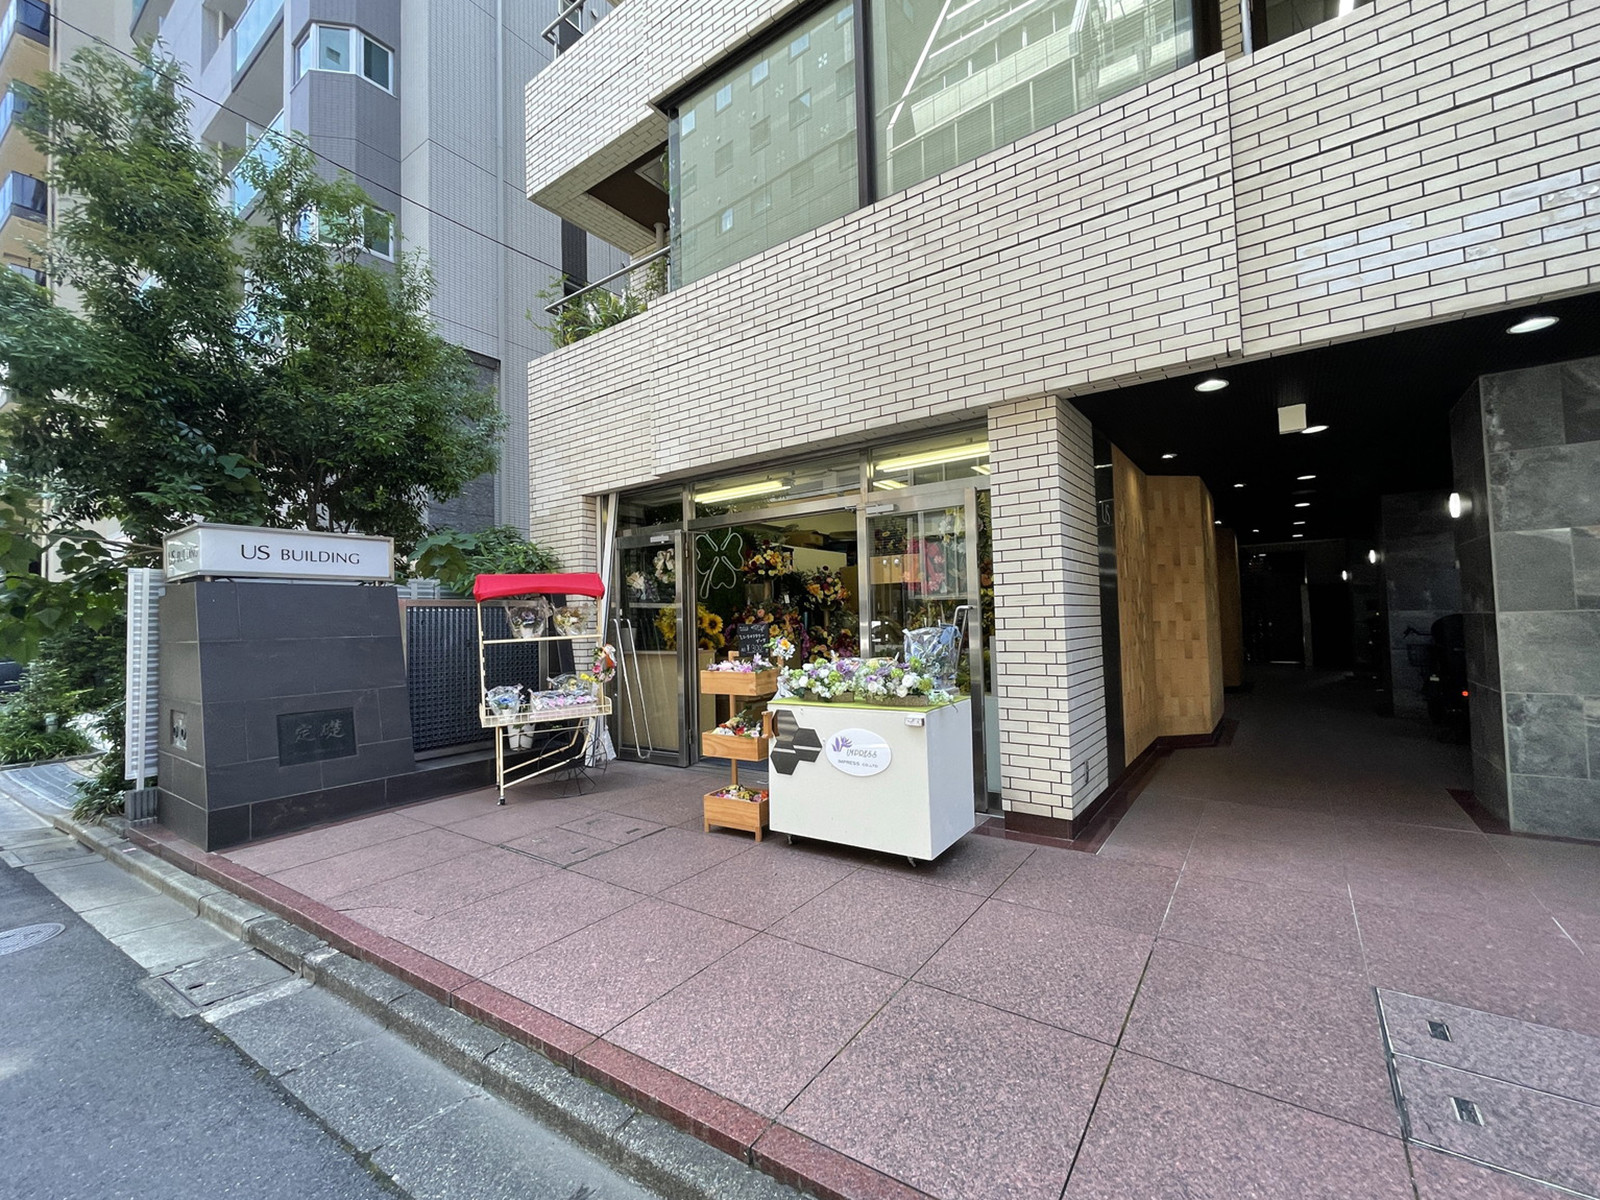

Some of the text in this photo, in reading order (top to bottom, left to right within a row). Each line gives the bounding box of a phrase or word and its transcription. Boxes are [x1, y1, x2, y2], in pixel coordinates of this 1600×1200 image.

[240, 544, 360, 565] US BUILDING
[295, 719, 345, 743] 定礎
